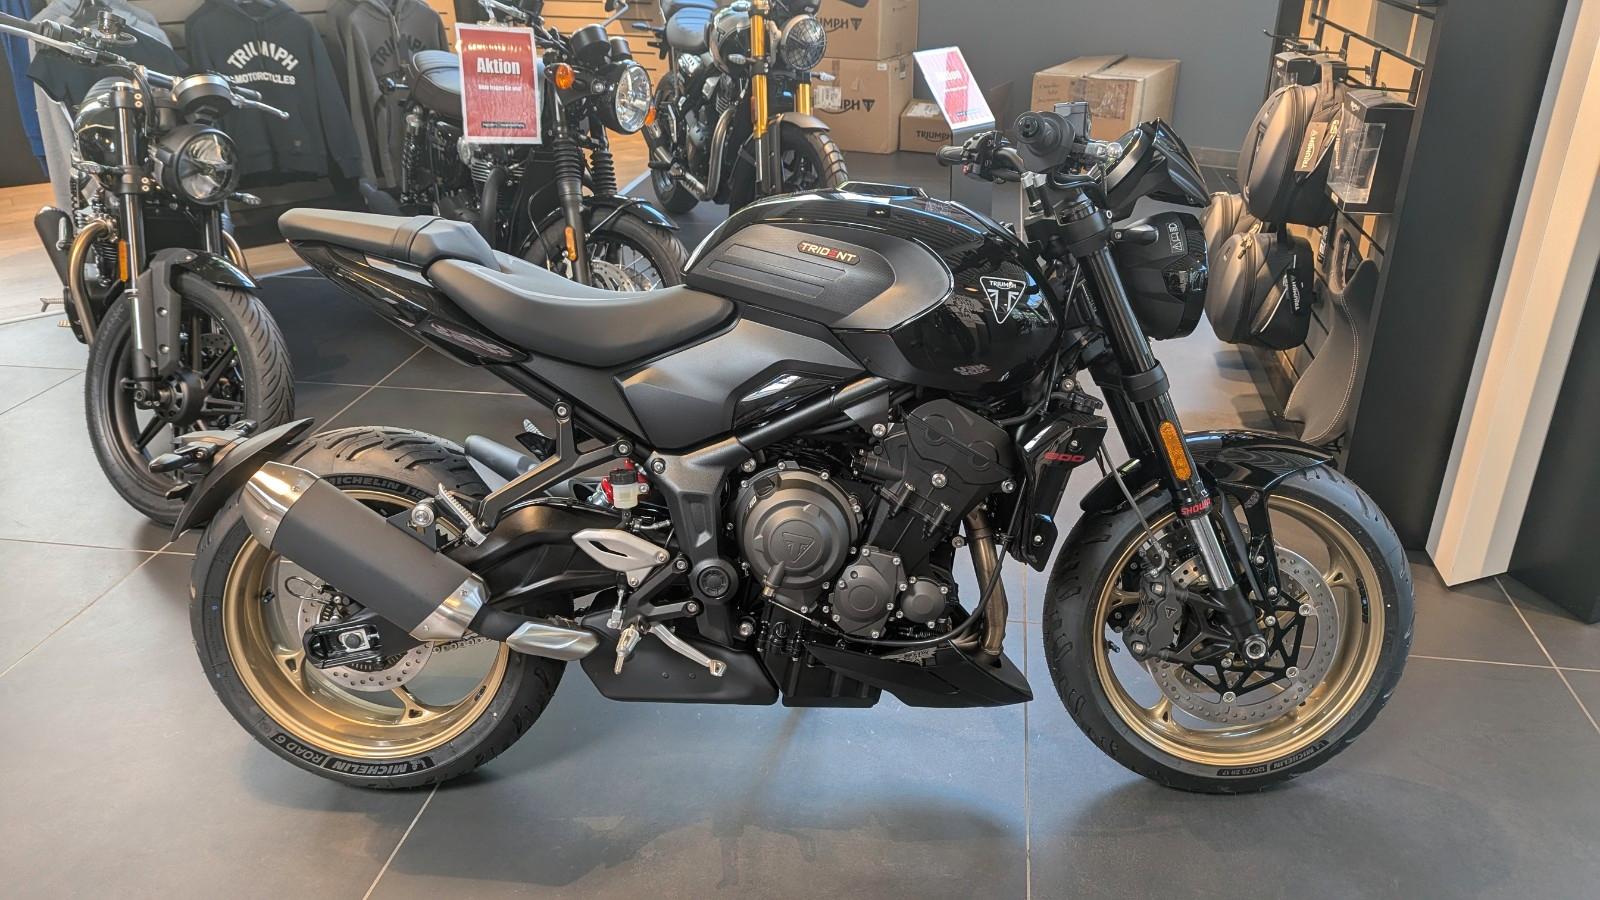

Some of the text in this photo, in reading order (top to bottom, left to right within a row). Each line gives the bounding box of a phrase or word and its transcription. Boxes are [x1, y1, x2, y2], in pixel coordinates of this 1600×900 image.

[226, 40, 299, 71] TRIUMPH
[477, 57, 521, 75] Aktion
[801, 242, 857, 261] TRIDENT
[990, 280, 1017, 289] TRIUMPH
[274, 734, 407, 775] MICHELIN ROAD 6
[1273, 749, 1314, 769] MICHELIN
